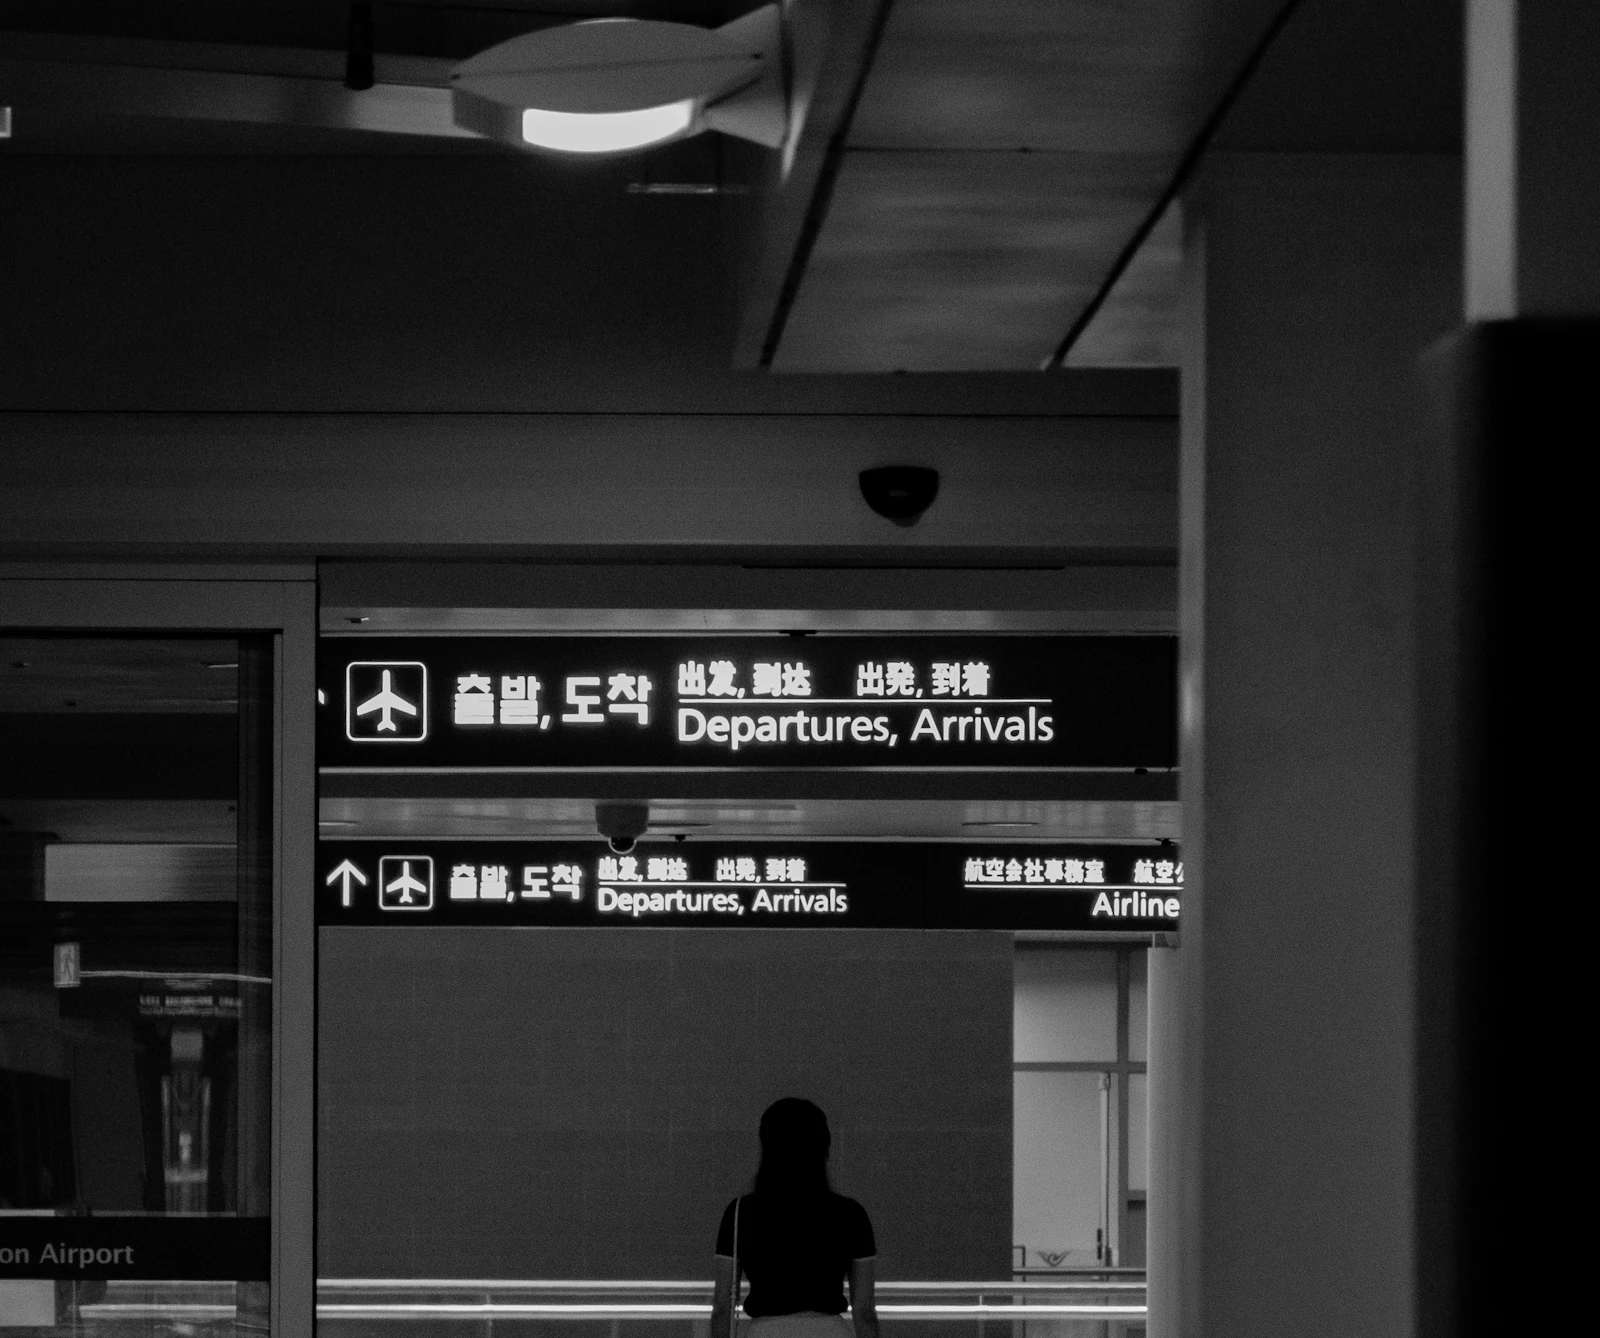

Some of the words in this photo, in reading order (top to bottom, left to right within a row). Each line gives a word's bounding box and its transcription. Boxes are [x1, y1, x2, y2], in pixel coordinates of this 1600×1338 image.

[454, 673, 551, 730] 출발,
[561, 673, 654, 726] 도착
[677, 708, 898, 751] Departures,
[910, 706, 1054, 742] Arrivals
[521, 864, 583, 900] 도착
[597, 887, 745, 917] Departures,
[751, 886, 848, 913] Arrivals
[1092, 890, 1182, 917] Airline
[39, 1242, 135, 1269] Airport
